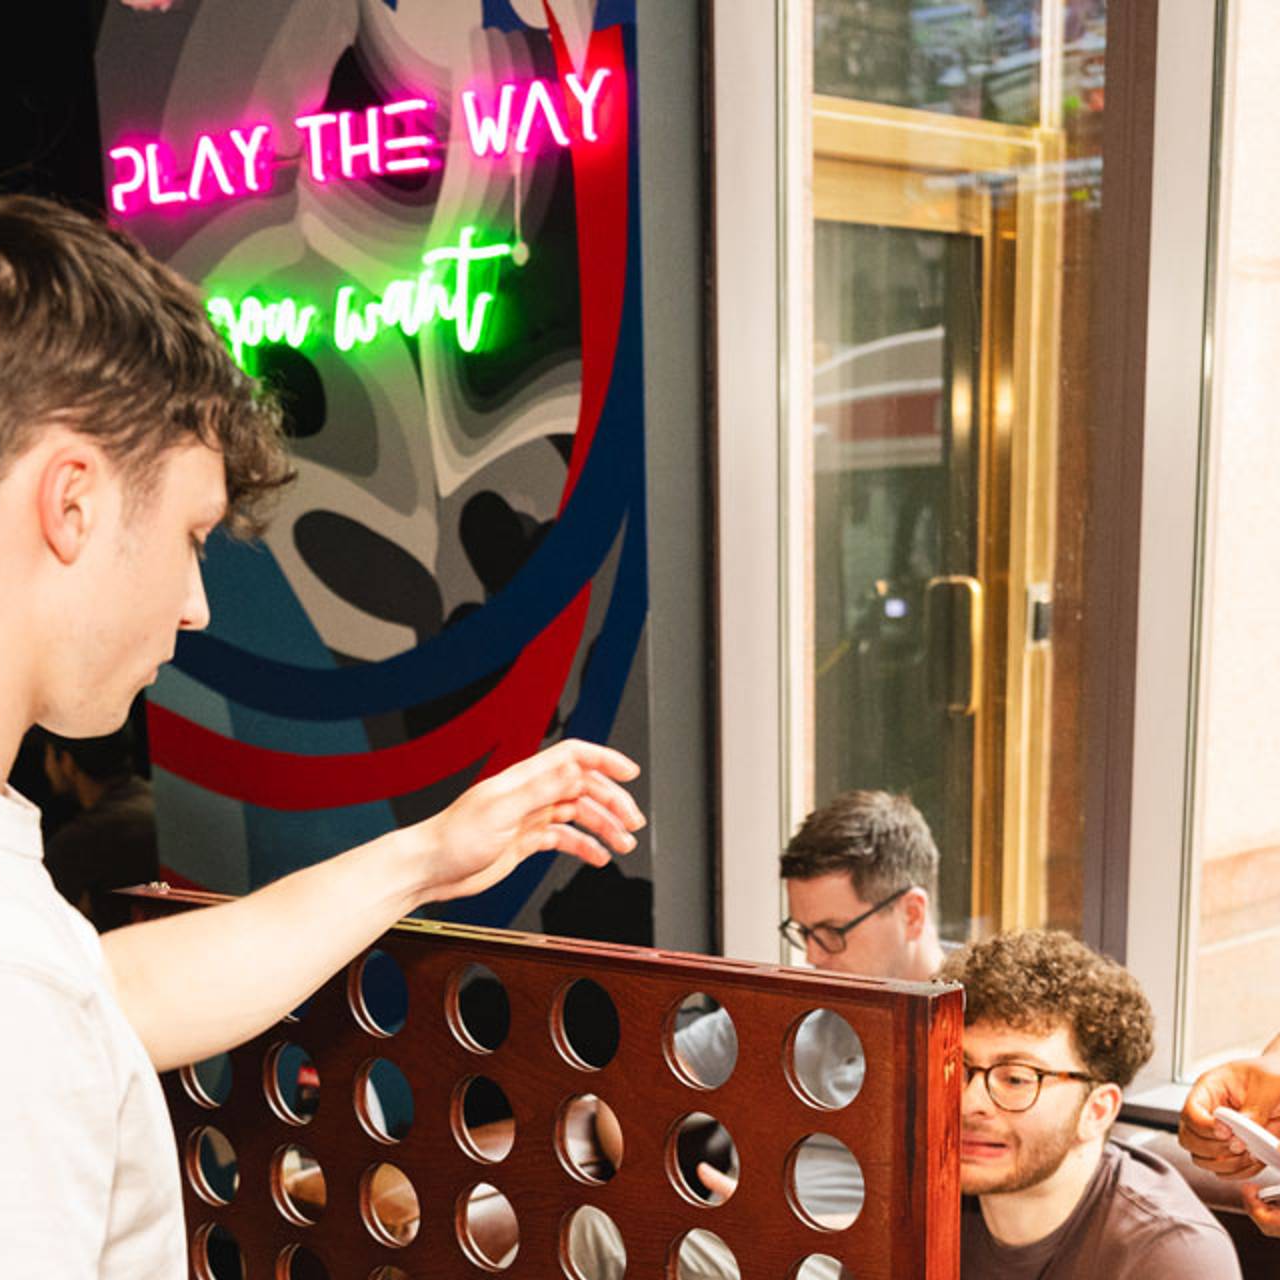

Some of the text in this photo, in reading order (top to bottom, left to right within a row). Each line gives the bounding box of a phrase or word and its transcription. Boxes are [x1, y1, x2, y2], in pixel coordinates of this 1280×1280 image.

[109, 67, 613, 212] PLAY THE WAY
[333, 225, 513, 353] want
